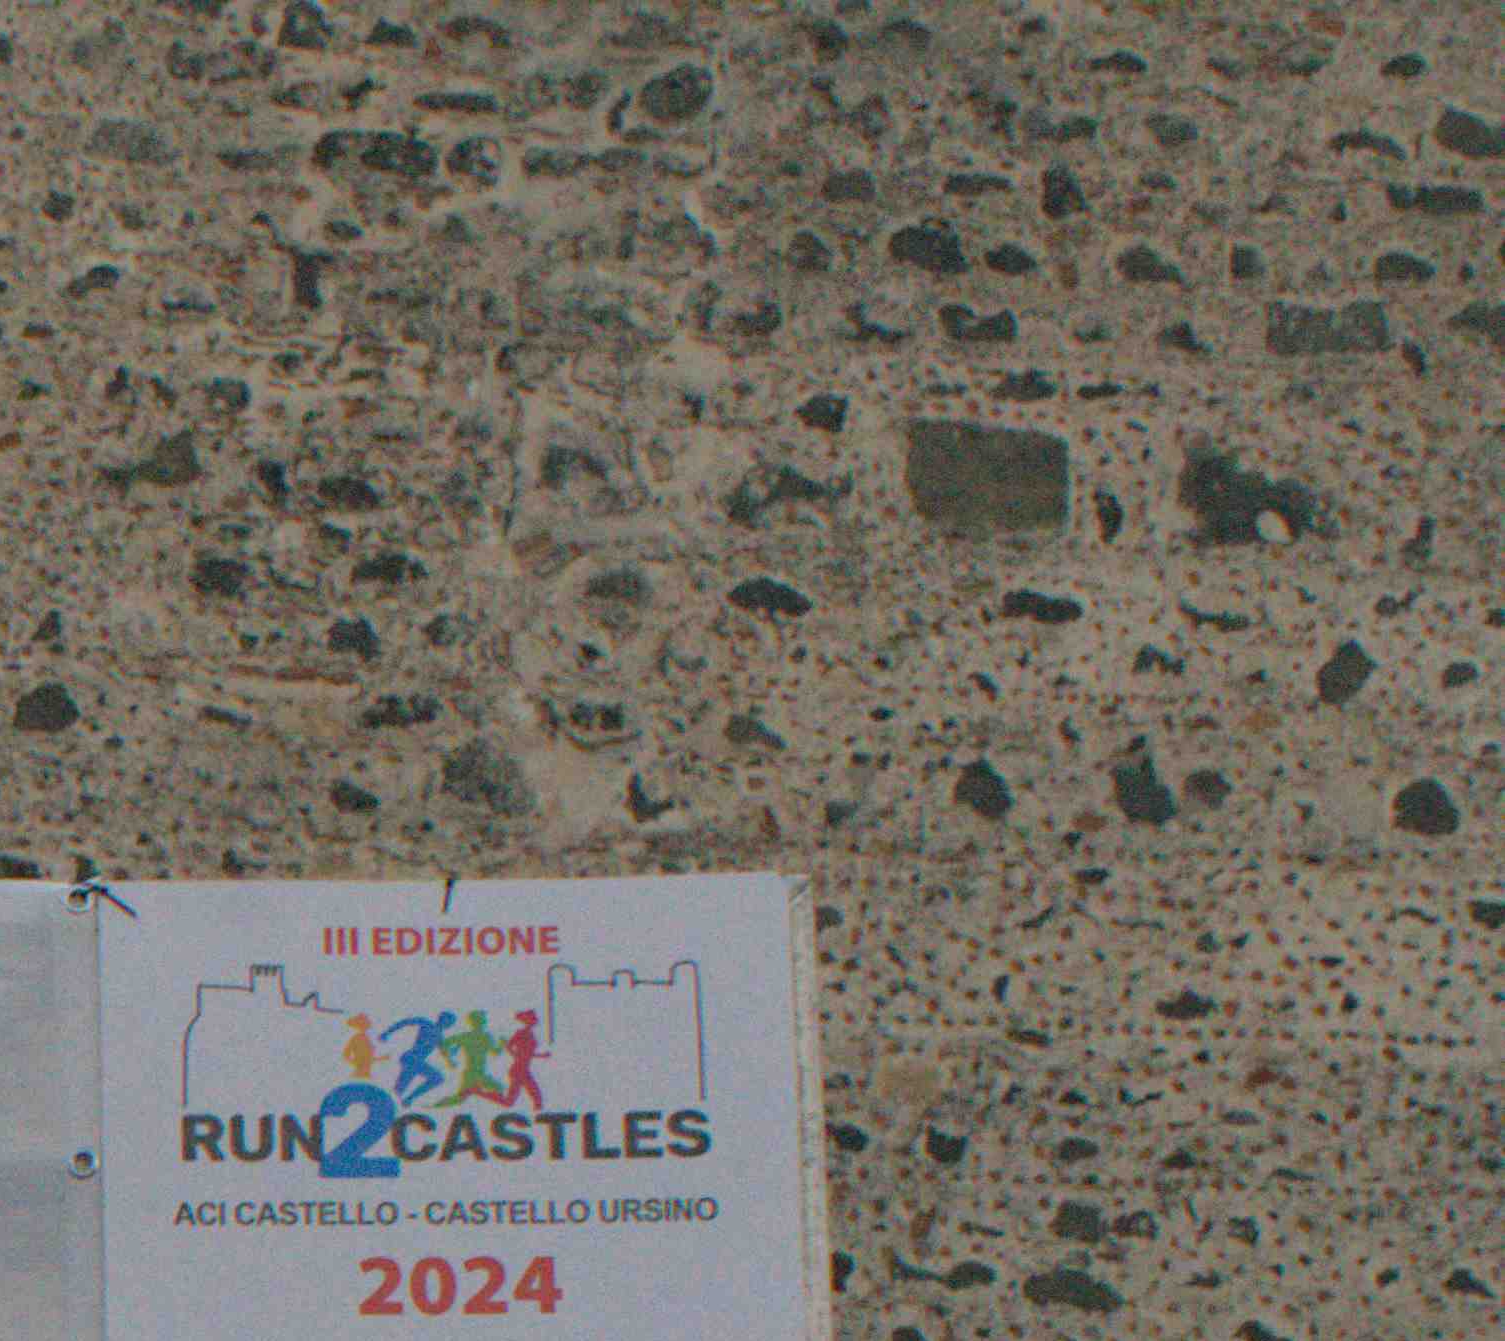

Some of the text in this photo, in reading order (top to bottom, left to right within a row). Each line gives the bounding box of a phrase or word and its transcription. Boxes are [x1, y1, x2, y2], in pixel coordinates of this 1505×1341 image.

[323, 925, 561, 957] III EDIZIONE
[180, 1083, 713, 1178] RUN2CASTLES
[174, 1203, 226, 1228] ACI
[234, 1201, 399, 1226] CASTELLO
[424, 1199, 591, 1225] CASTELLO
[599, 1197, 719, 1223] URSINO
[357, 1256, 564, 1317] 2024
